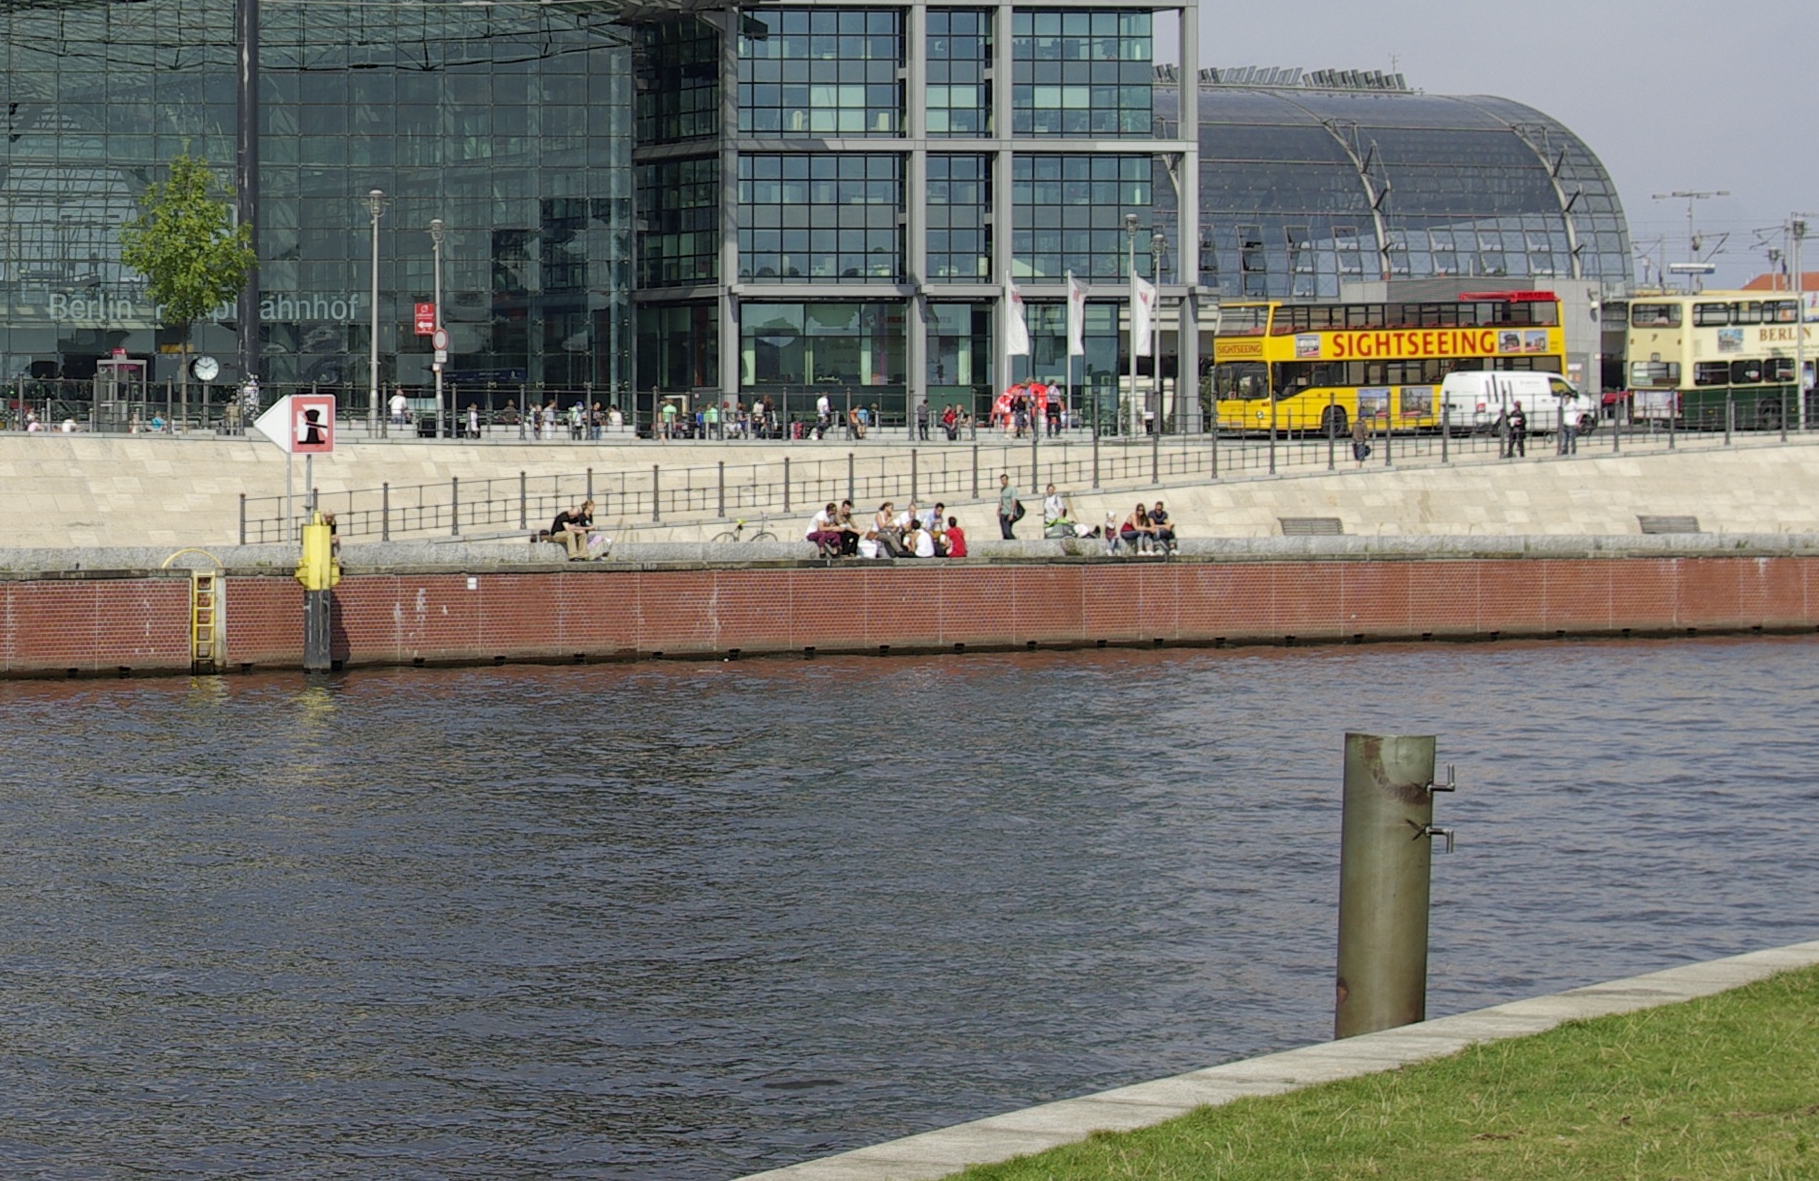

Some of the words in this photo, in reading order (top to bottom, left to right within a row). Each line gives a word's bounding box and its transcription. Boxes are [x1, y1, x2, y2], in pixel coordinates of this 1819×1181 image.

[49, 293, 132, 320] Berlin
[156, 293, 359, 325] ptahnhof
[1333, 330, 1495, 357] SIGHTSEEING
[1759, 326, 1812, 342] BERLN
[1217, 343, 1262, 355] SIGHTSEEING
